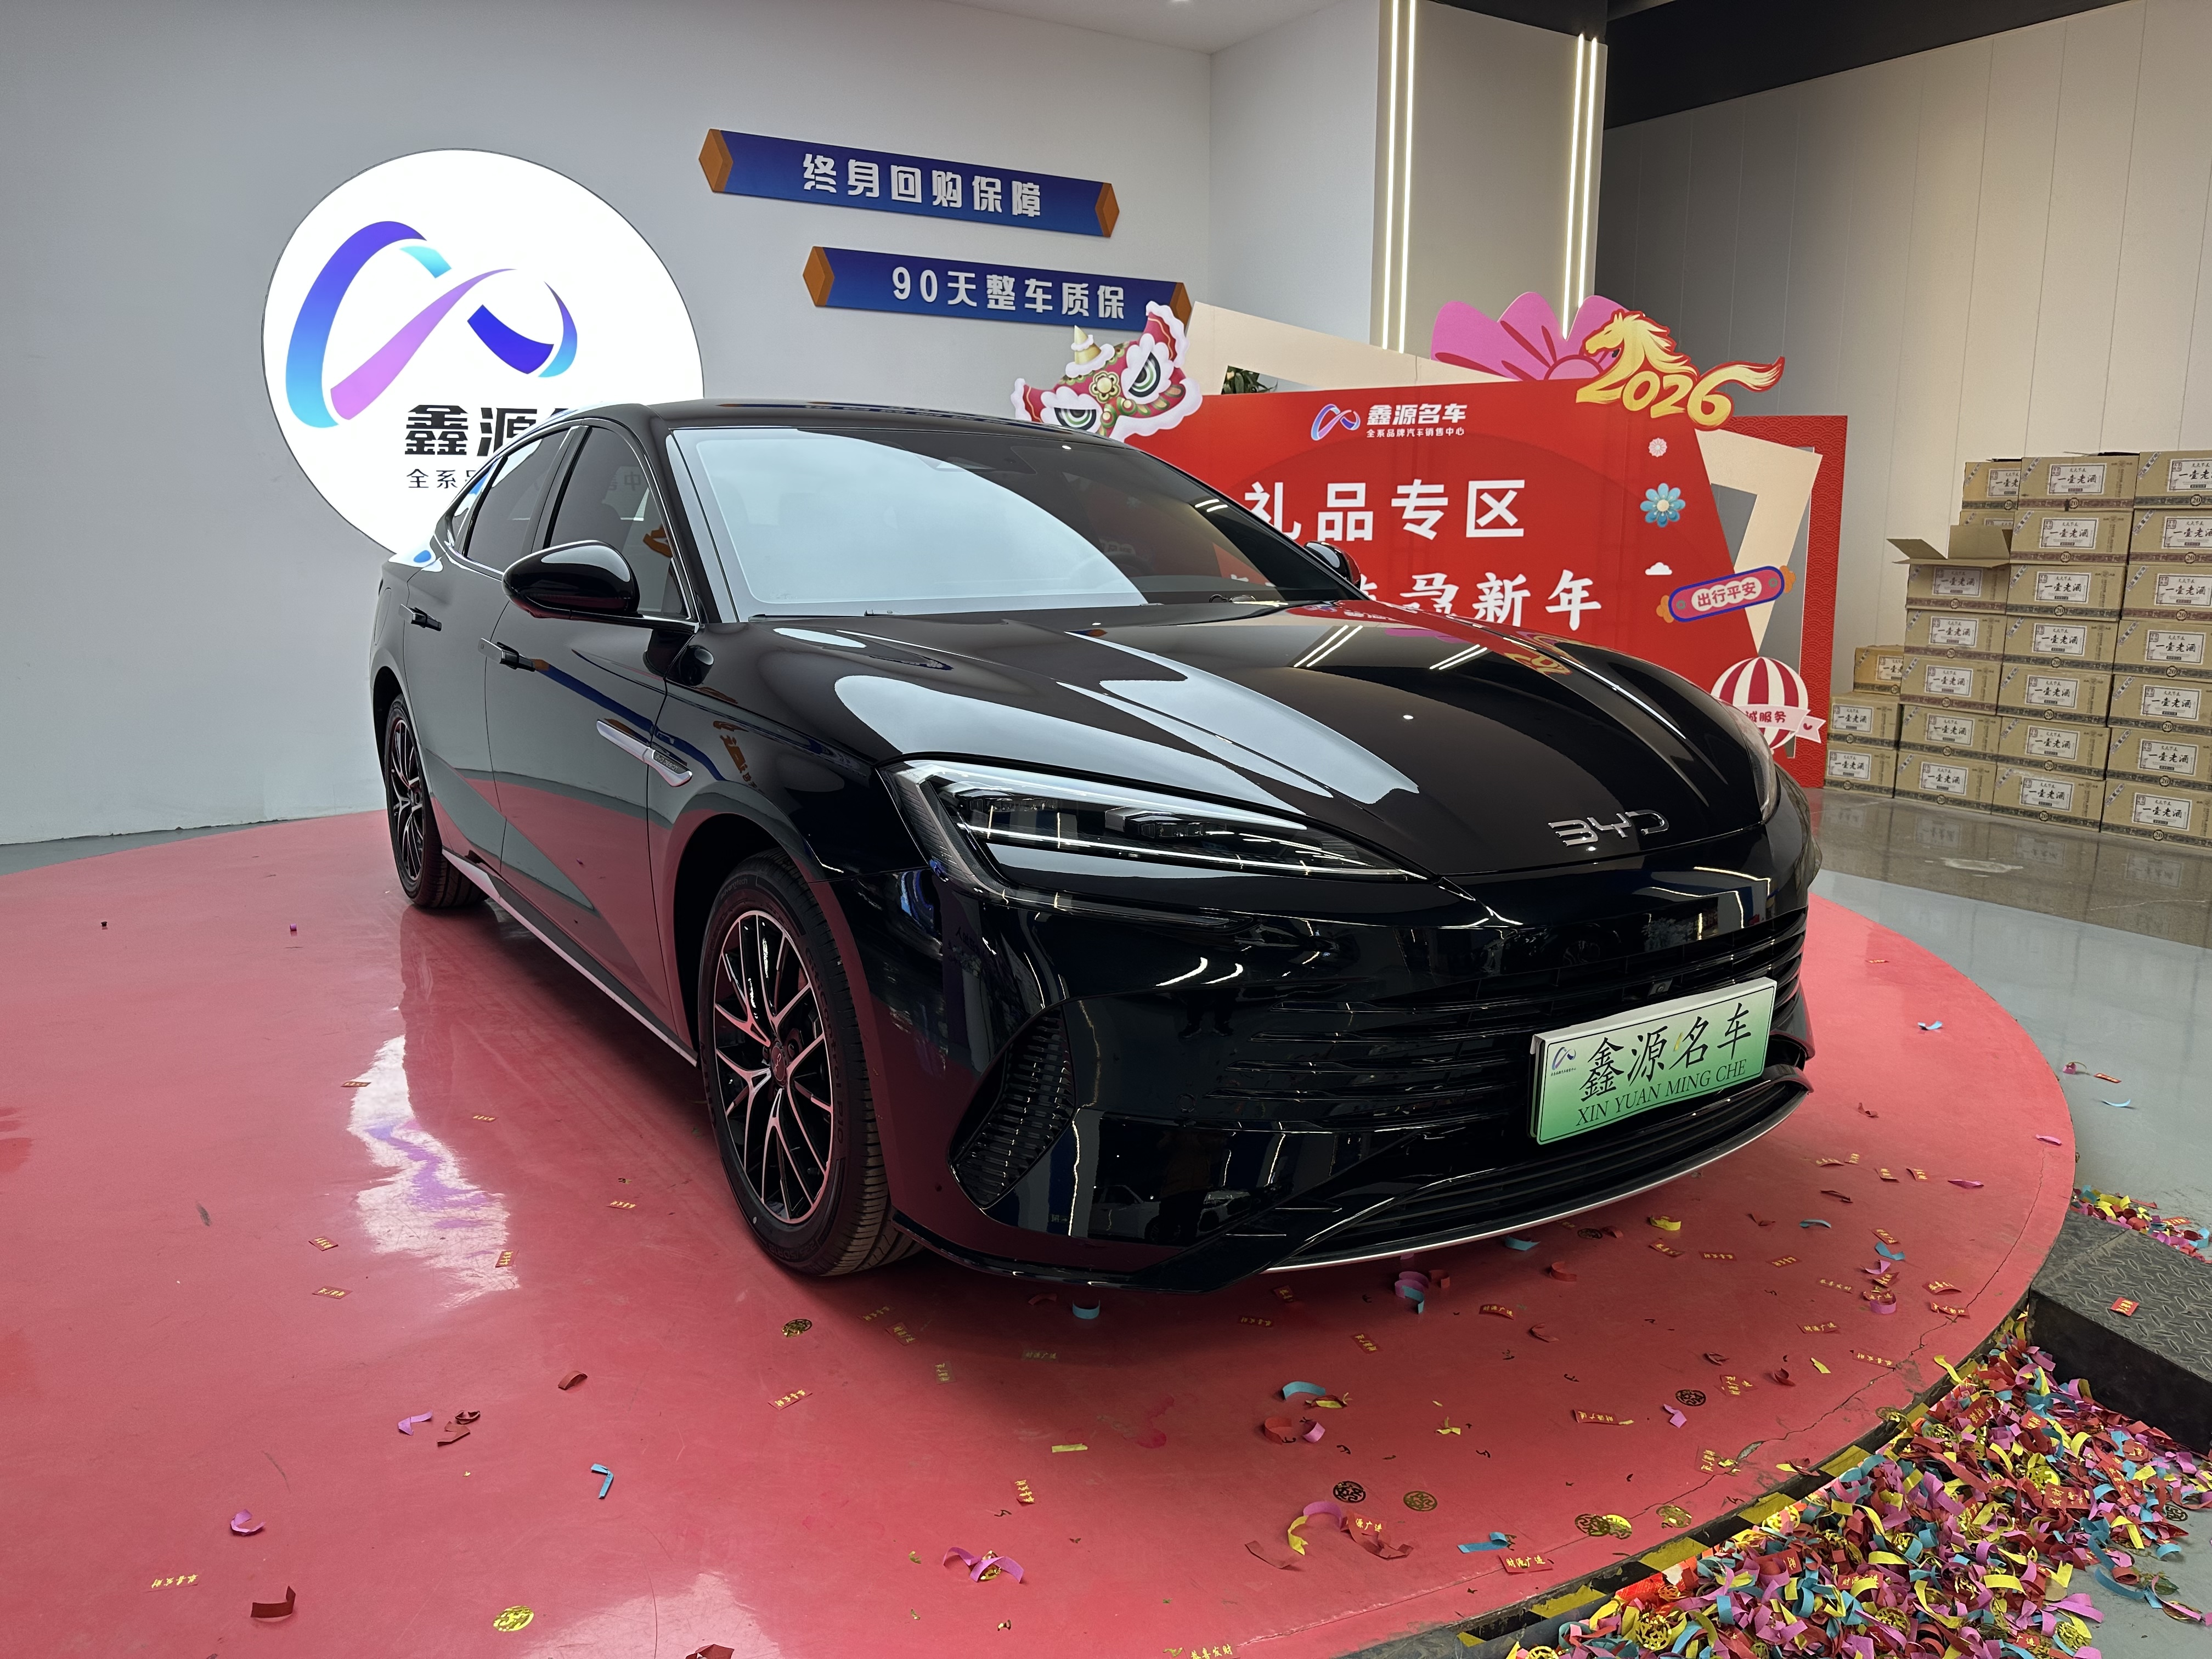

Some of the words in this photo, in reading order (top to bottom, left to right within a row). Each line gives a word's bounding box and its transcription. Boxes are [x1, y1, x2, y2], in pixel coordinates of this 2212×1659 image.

[803, 153, 1041, 218] 终身回购保障
[893, 266, 1125, 319] 90天整车质保
[1367, 403, 1468, 425] 鑫源名车
[405, 405, 568, 456] 鑫源
[1366, 427, 1464, 438] 全系品牌汽车销售中心
[2179, 469, 2212, 479] 一壶老
[1244, 478, 1525, 541] 礼品专区
[1697, 582, 1756, 607] 出行平安
[1548, 810, 1669, 847] BYD
[1579, 1002, 1751, 1102] 鑫源名车
[1576, 1101, 1609, 1126] XIN
[1615, 1084, 1661, 1114] YUAN
[1664, 1070, 1711, 1097] MING
[1716, 1059, 1747, 1082] CHE
[1482, 1305, 1513, 1317] 财源广进
[1345, 1517, 1382, 1533] 源广进
[1506, 1555, 1545, 1568] 财源广进
[1842, 1572, 1878, 1587] 财源进
[1190, 1644, 1232, 1658] 恭喜发财
